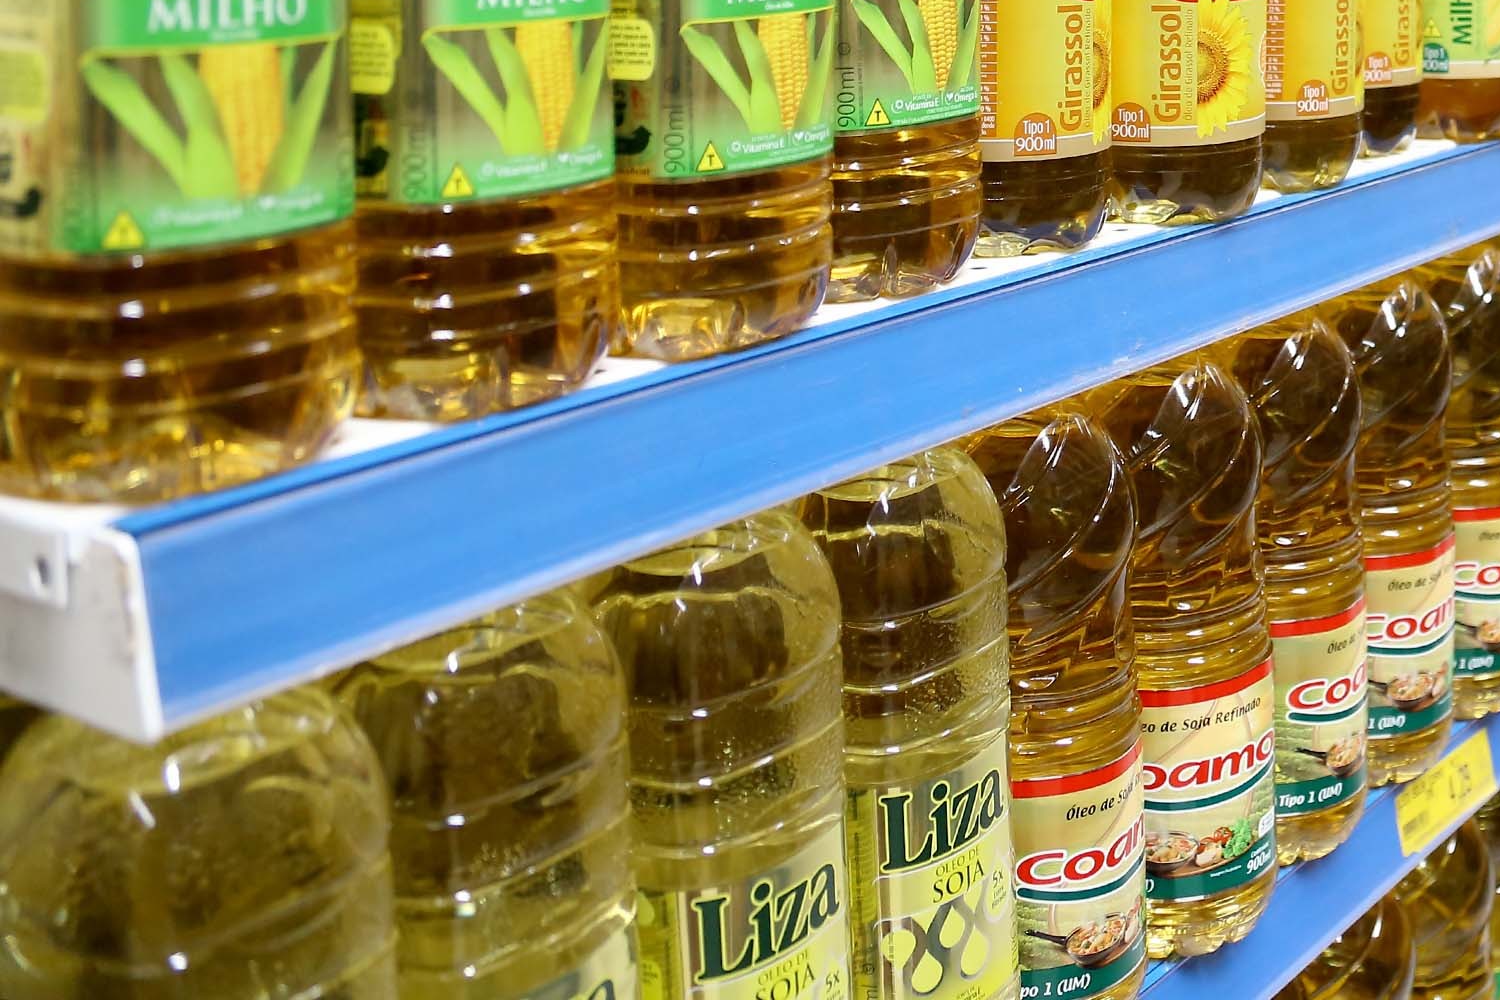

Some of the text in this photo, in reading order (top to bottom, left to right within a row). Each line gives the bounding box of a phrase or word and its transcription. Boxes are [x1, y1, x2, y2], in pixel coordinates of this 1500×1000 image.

[1184, 9, 1193, 48] Refinado
[1057, 4, 1083, 131] Girassol
[1151, 5, 1182, 123] Girassol
[1184, 51, 1193, 85] Girassol
[1368, 56, 1382, 71] Tipo
[835, 67, 856, 127] 900ml
[1297, 99, 1329, 112] 900ml
[1303, 85, 1320, 101] Tipo
[905, 100, 934, 112] Vitamina
[1117, 108, 1144, 128] Tipo 1
[663, 105, 686, 174] 900ml
[1022, 119, 1050, 139] Tipo 1
[1112, 123, 1150, 138] 900ml
[1015, 136, 1055, 152] 900ml
[1388, 577, 1411, 591] Óleo
[1327, 638, 1347, 655] Óleo
[1160, 720, 1177, 733] de
[1182, 716, 1211, 732] Soja
[1215, 697, 1261, 726] Refinado
[1144, 729, 1275, 790] oamo
[1279, 792, 1305, 808] Tipo
[1318, 782, 1343, 803] (UM)
[879, 769, 1005, 872] Liza
[1066, 804, 1095, 821] Óleo
[1100, 797, 1115, 813] de
[932, 863, 985, 904] SOJA
[694, 864, 840, 980] Liza
[1057, 973, 1091, 996] (UM)
